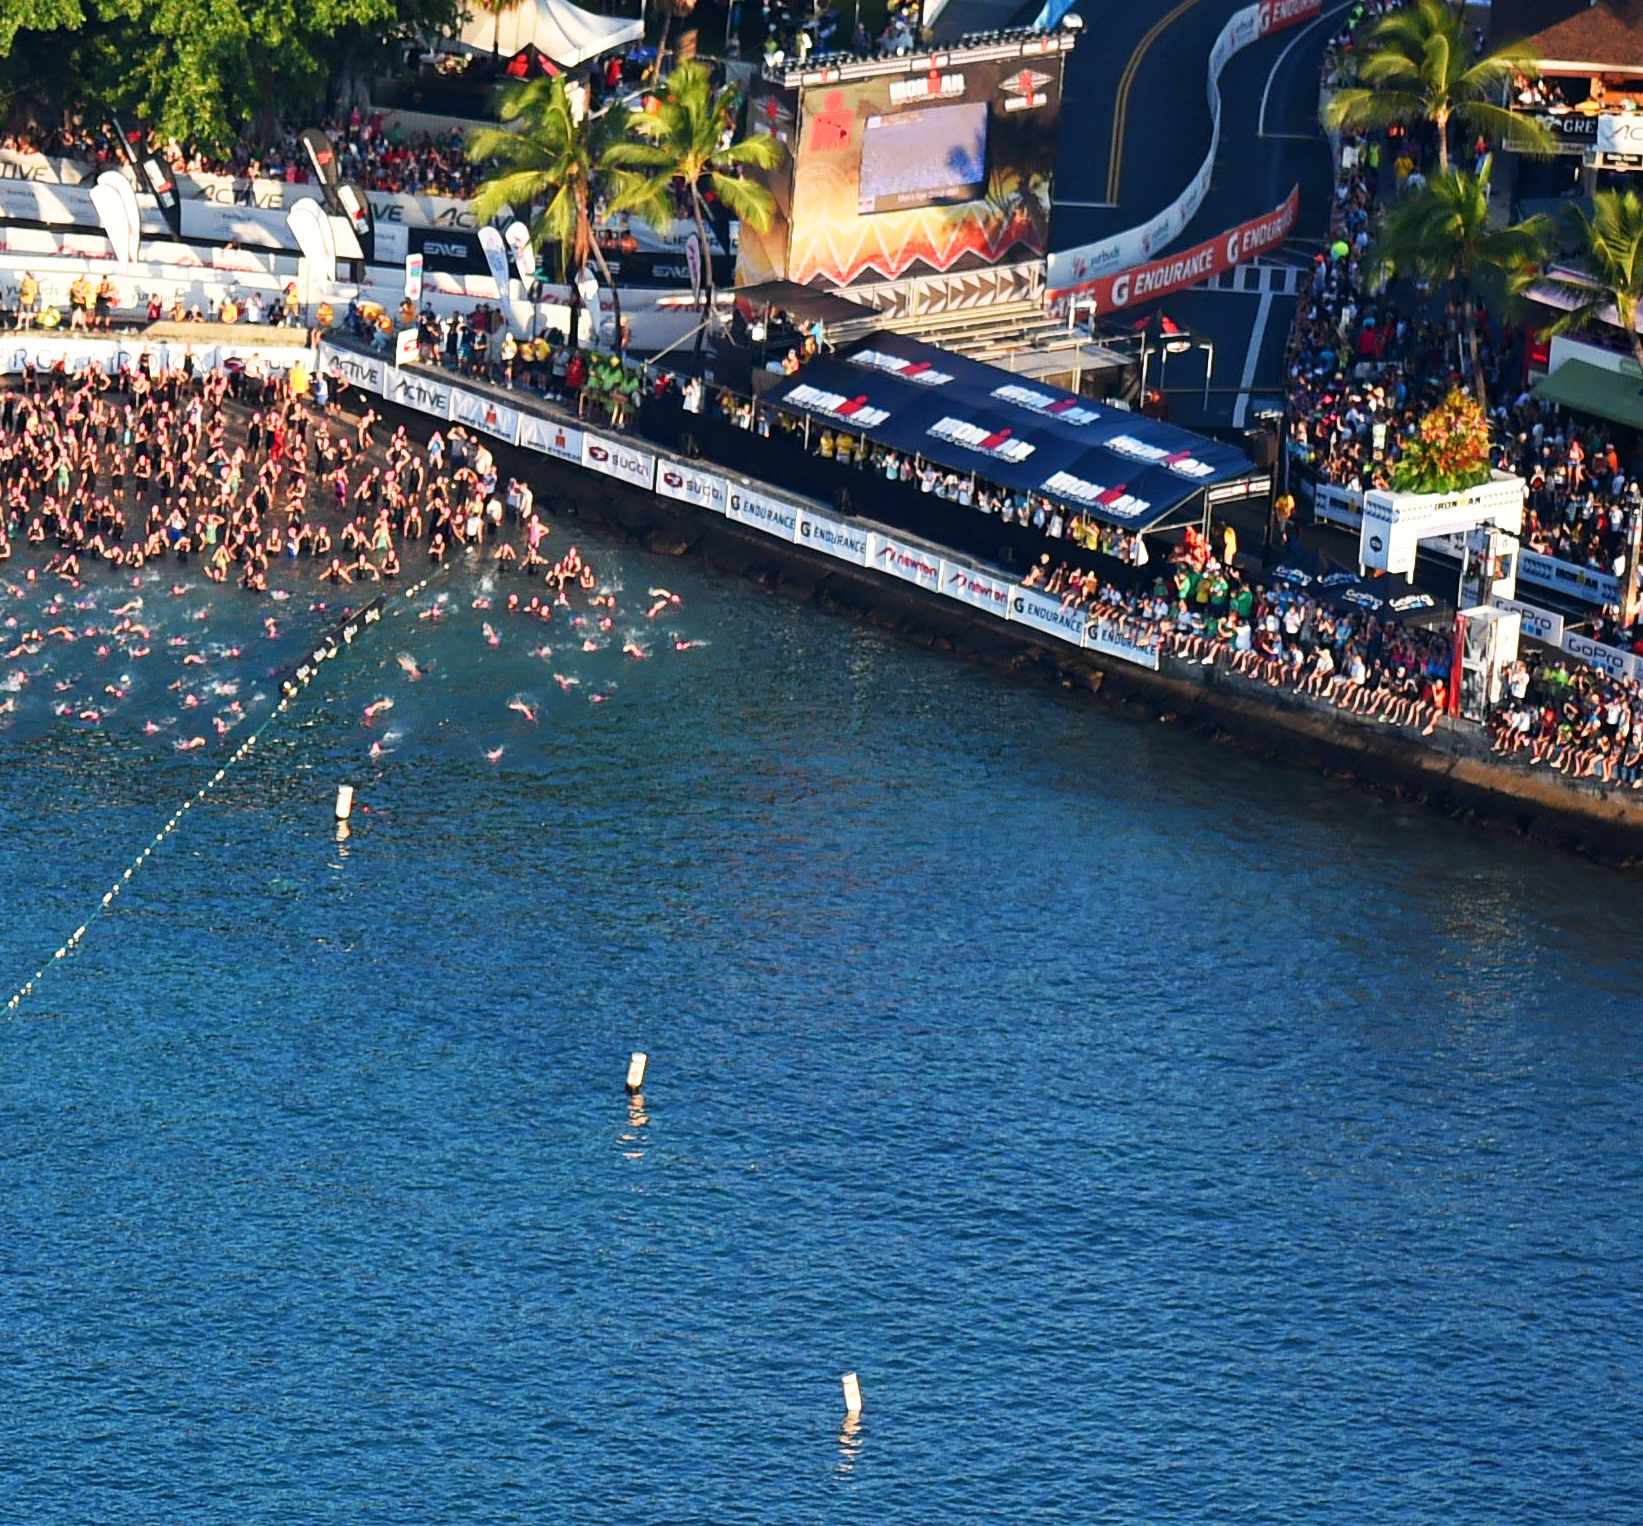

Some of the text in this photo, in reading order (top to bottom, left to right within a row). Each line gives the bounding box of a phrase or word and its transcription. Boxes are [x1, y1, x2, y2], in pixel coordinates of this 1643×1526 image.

[1227, 232, 1239, 264] G
[1111, 275, 1129, 307] G
[1134, 248, 1213, 296] ENDURANCE
[328, 356, 378, 385] ACTIVE
[394, 379, 446, 409] ACTIVE
[743, 500, 796, 530] ENDURANCE
[813, 526, 866, 554] ENDURANCE
[1027, 602, 1084, 634] ENDURANCE
[1567, 636, 1624, 669] GoPro
